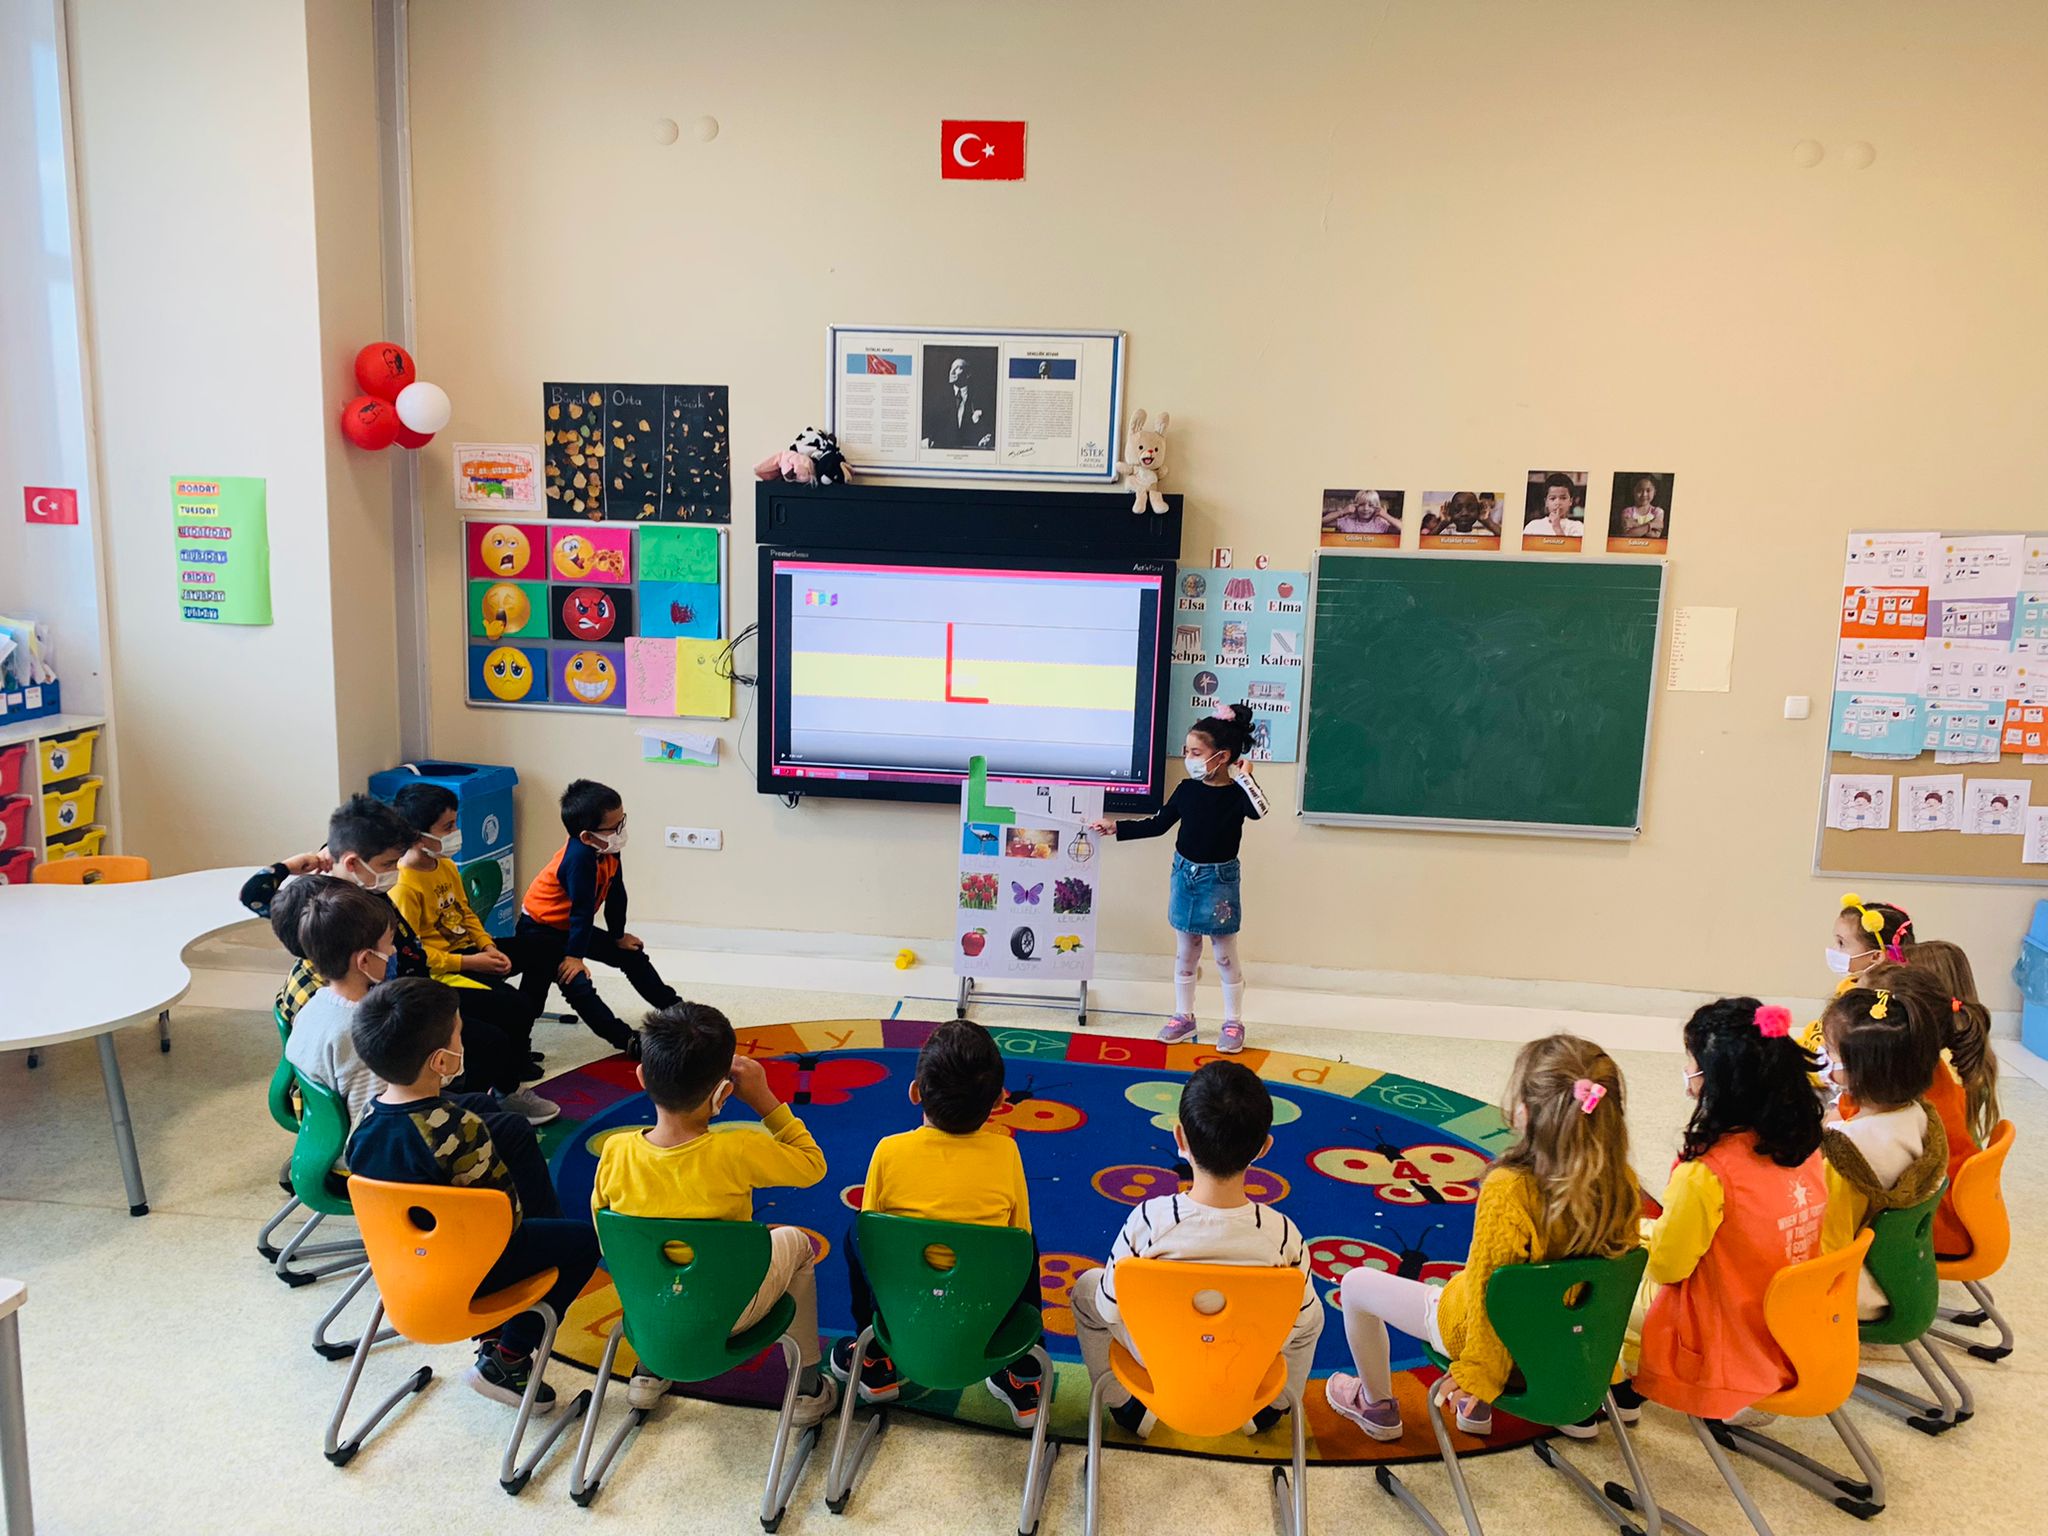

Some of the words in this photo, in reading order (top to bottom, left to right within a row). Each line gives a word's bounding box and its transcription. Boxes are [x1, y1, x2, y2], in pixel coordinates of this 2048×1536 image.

[612, 390, 642, 406] Orta
[178, 484, 216, 494] MONDAY
[180, 506, 216, 515] TUESDAY
[179, 528, 230, 538] WEDNESDAY
[1215, 548, 1231, 568] E
[1255, 555, 1268, 570] e
[183, 573, 214, 582] FRIDAY
[1179, 599, 1205, 611] Elsa
[1223, 600, 1253, 612] Etek
[1269, 601, 1302, 613] Elma
[946, 622, 989, 704] L
[1215, 654, 1250, 667] Dergi
[1261, 655, 1302, 667] Kalem
[1191, 697, 1220, 708] Bale
[1251, 749, 1272, 760] Efe
[967, 755, 1016, 825] L
[1071, 796, 1083, 814] L
[1004, 1039, 1037, 1053] a
[1098, 1041, 1132, 1061] b
[1292, 1066, 1332, 1085] d
[1392, 1160, 1431, 1184] 4
